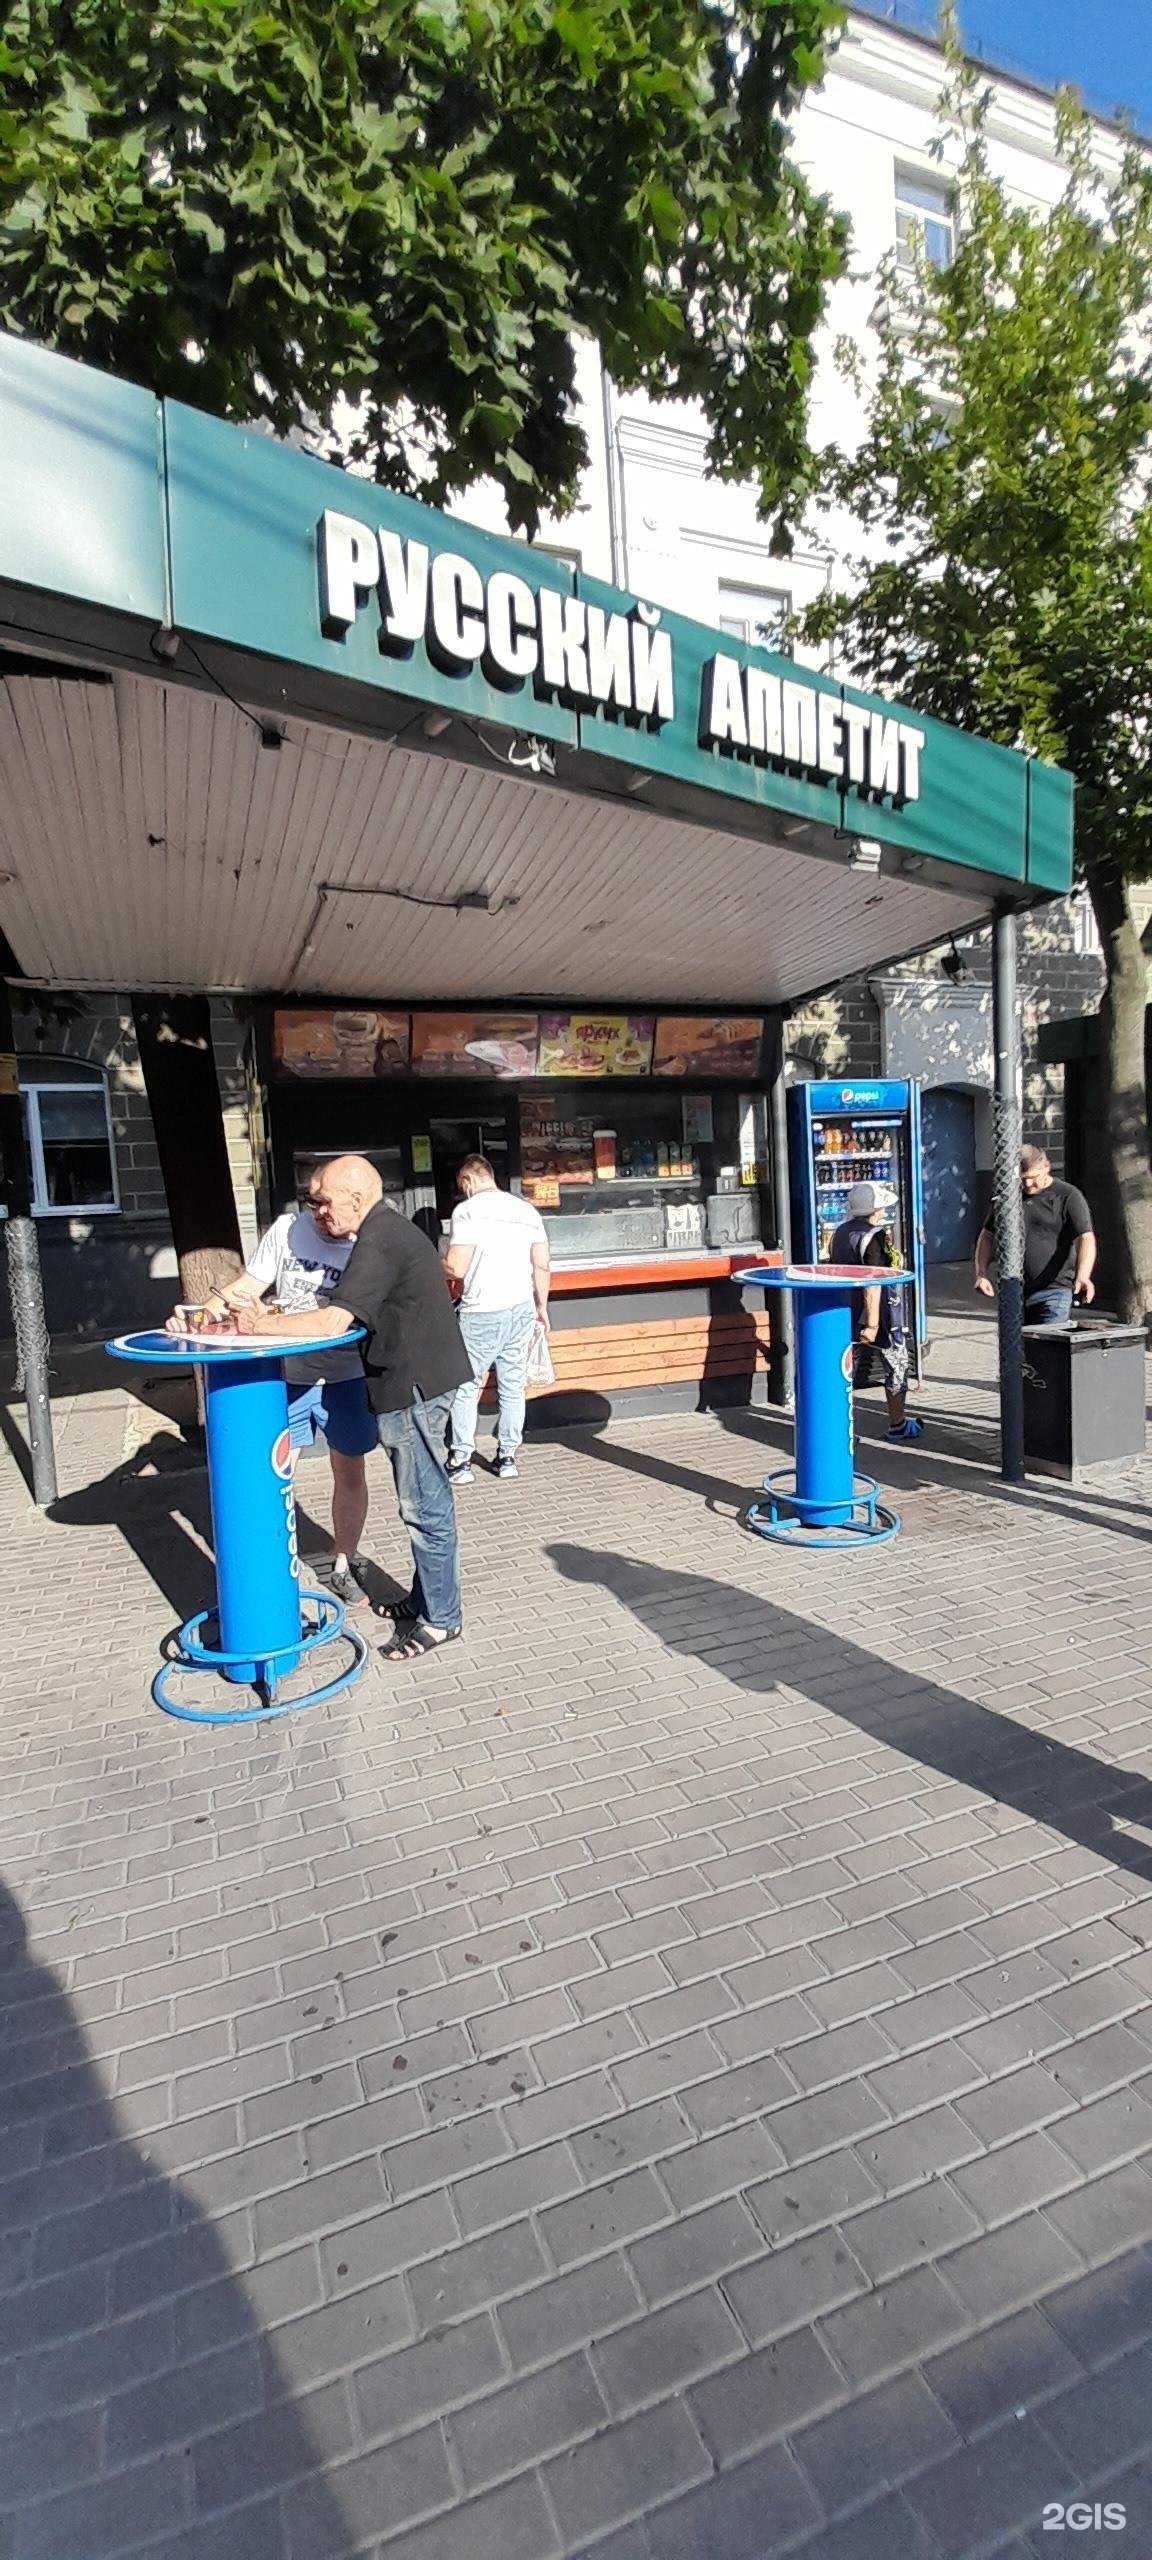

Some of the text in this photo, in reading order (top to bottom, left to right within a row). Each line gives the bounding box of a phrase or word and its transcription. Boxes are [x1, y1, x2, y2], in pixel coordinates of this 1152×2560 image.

[322, 508, 926, 802] РУССКИЙ АППЕТИТ
[322, 1263, 342, 1282] YO
